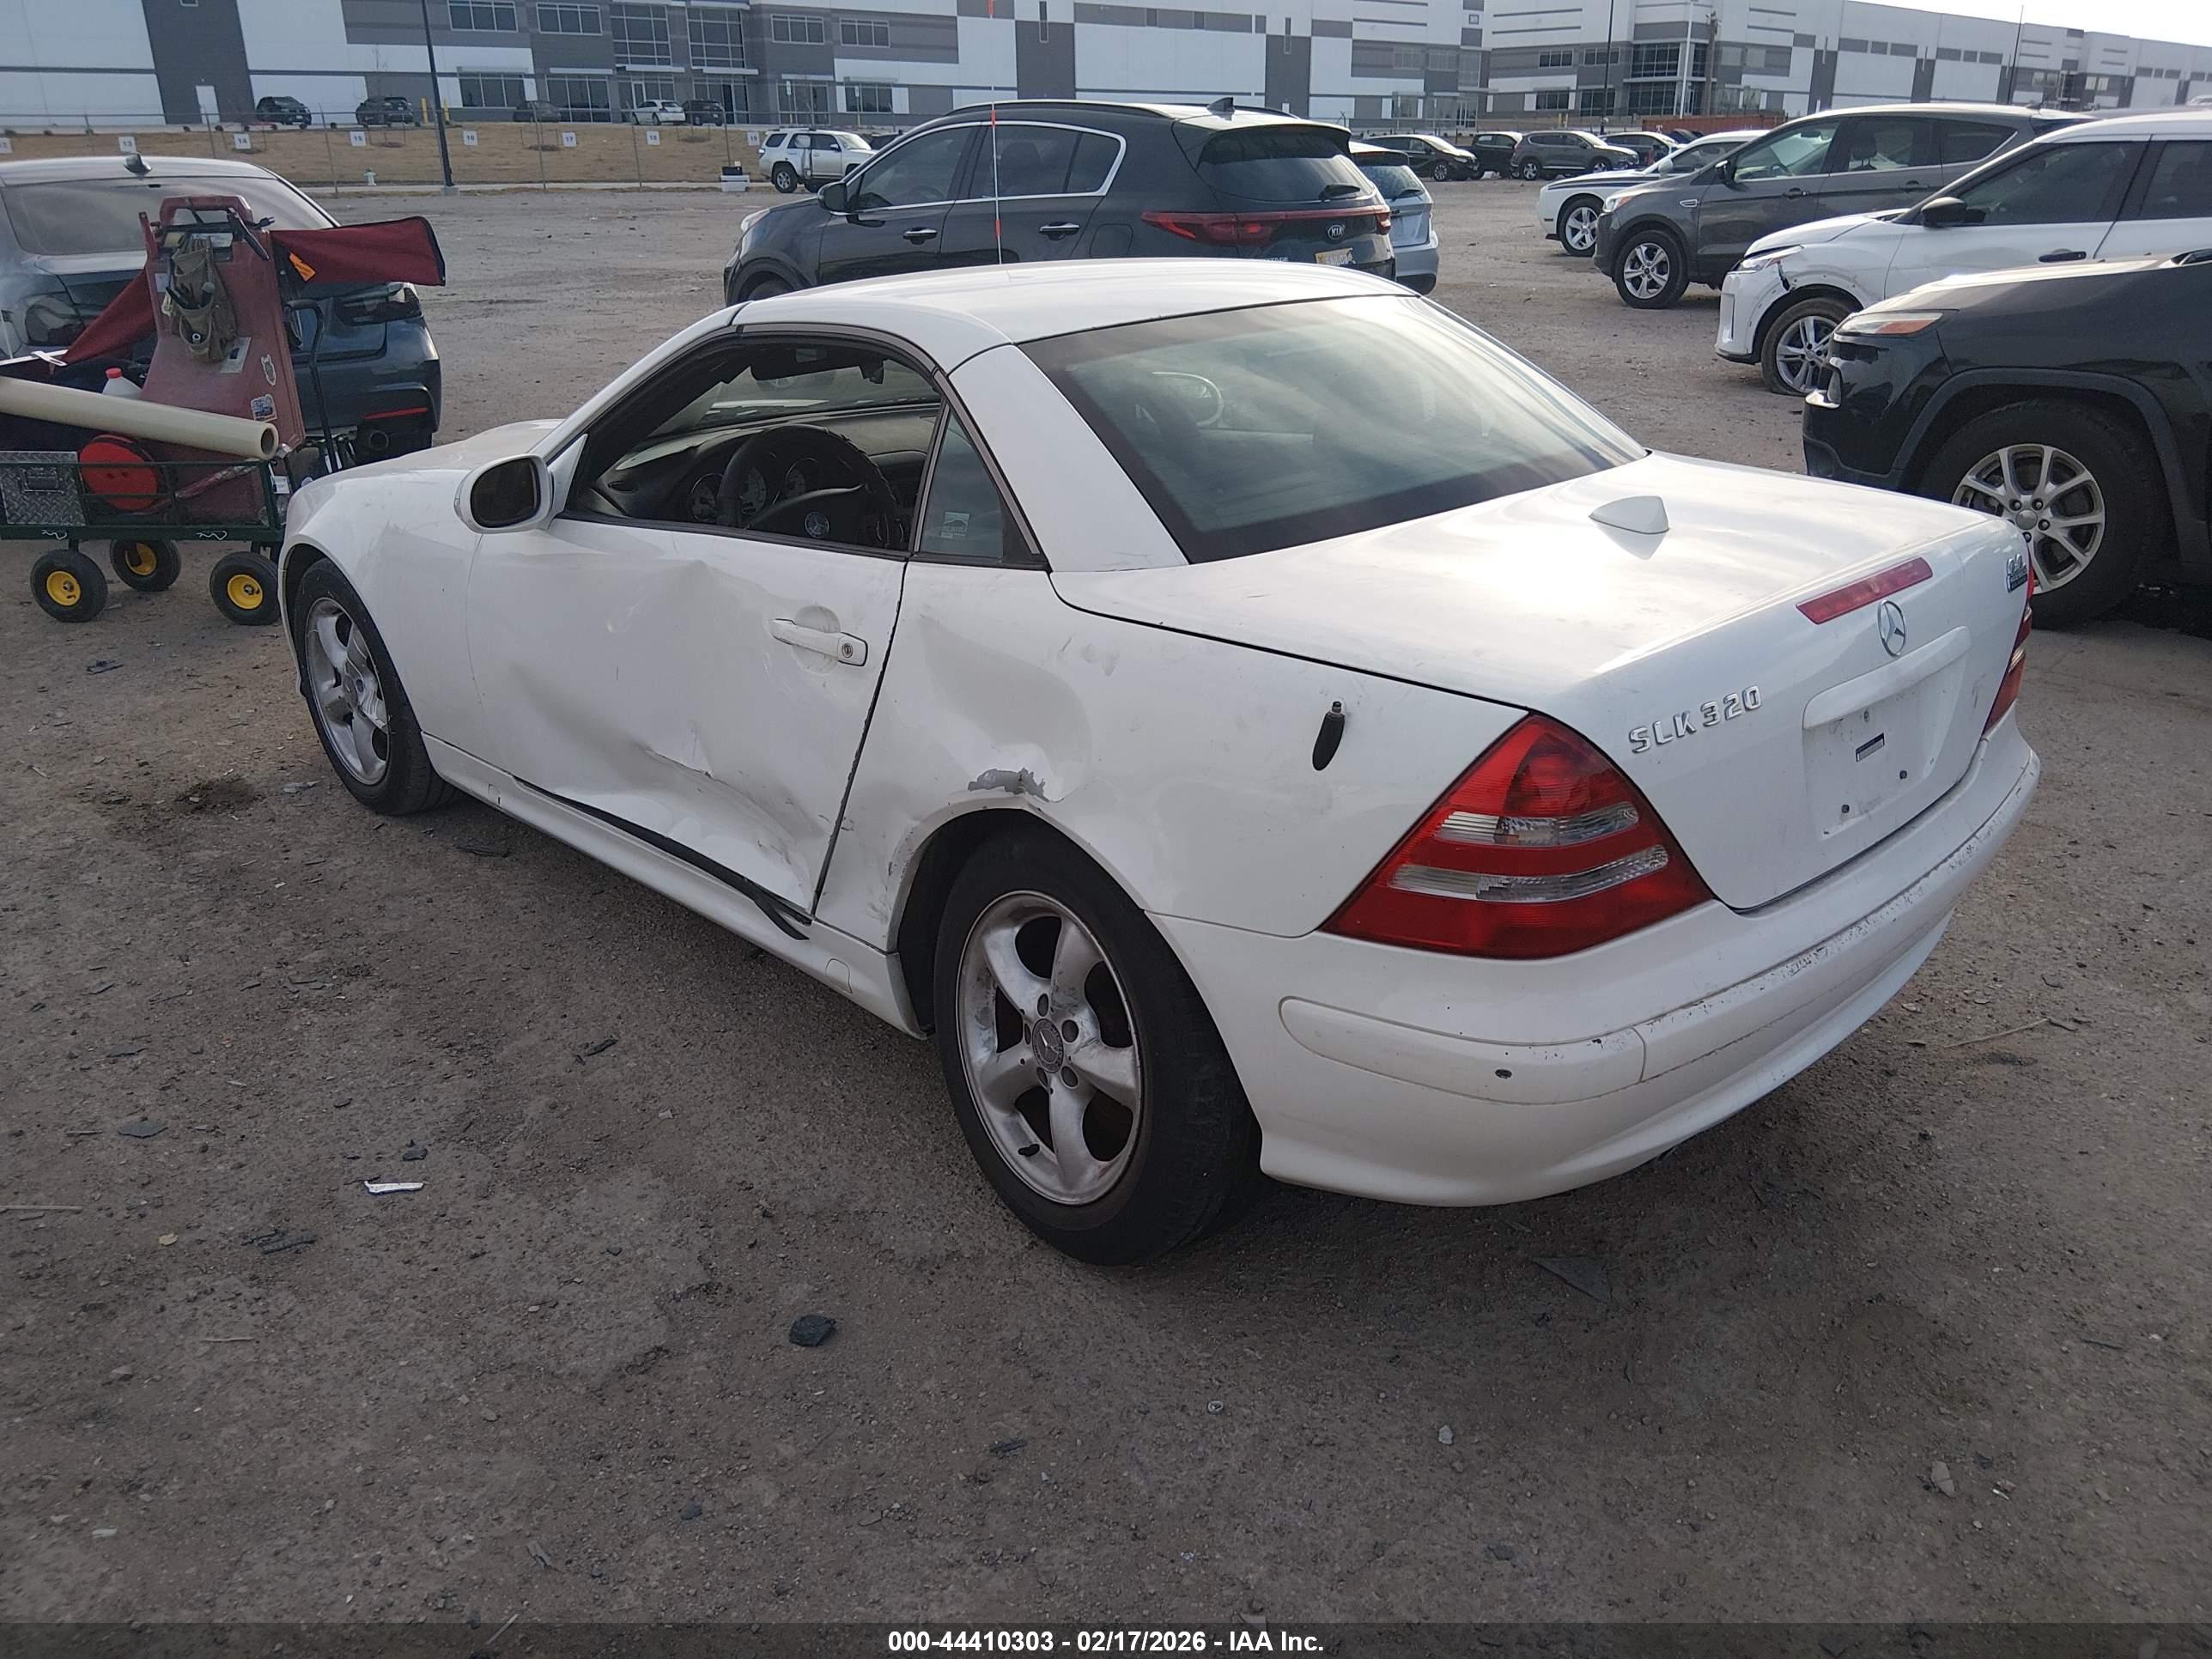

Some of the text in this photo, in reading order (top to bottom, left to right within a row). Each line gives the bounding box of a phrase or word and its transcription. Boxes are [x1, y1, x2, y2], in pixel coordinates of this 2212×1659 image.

[1330, 226, 1344, 238] KIA
[1628, 684, 1762, 753] SLK 320
